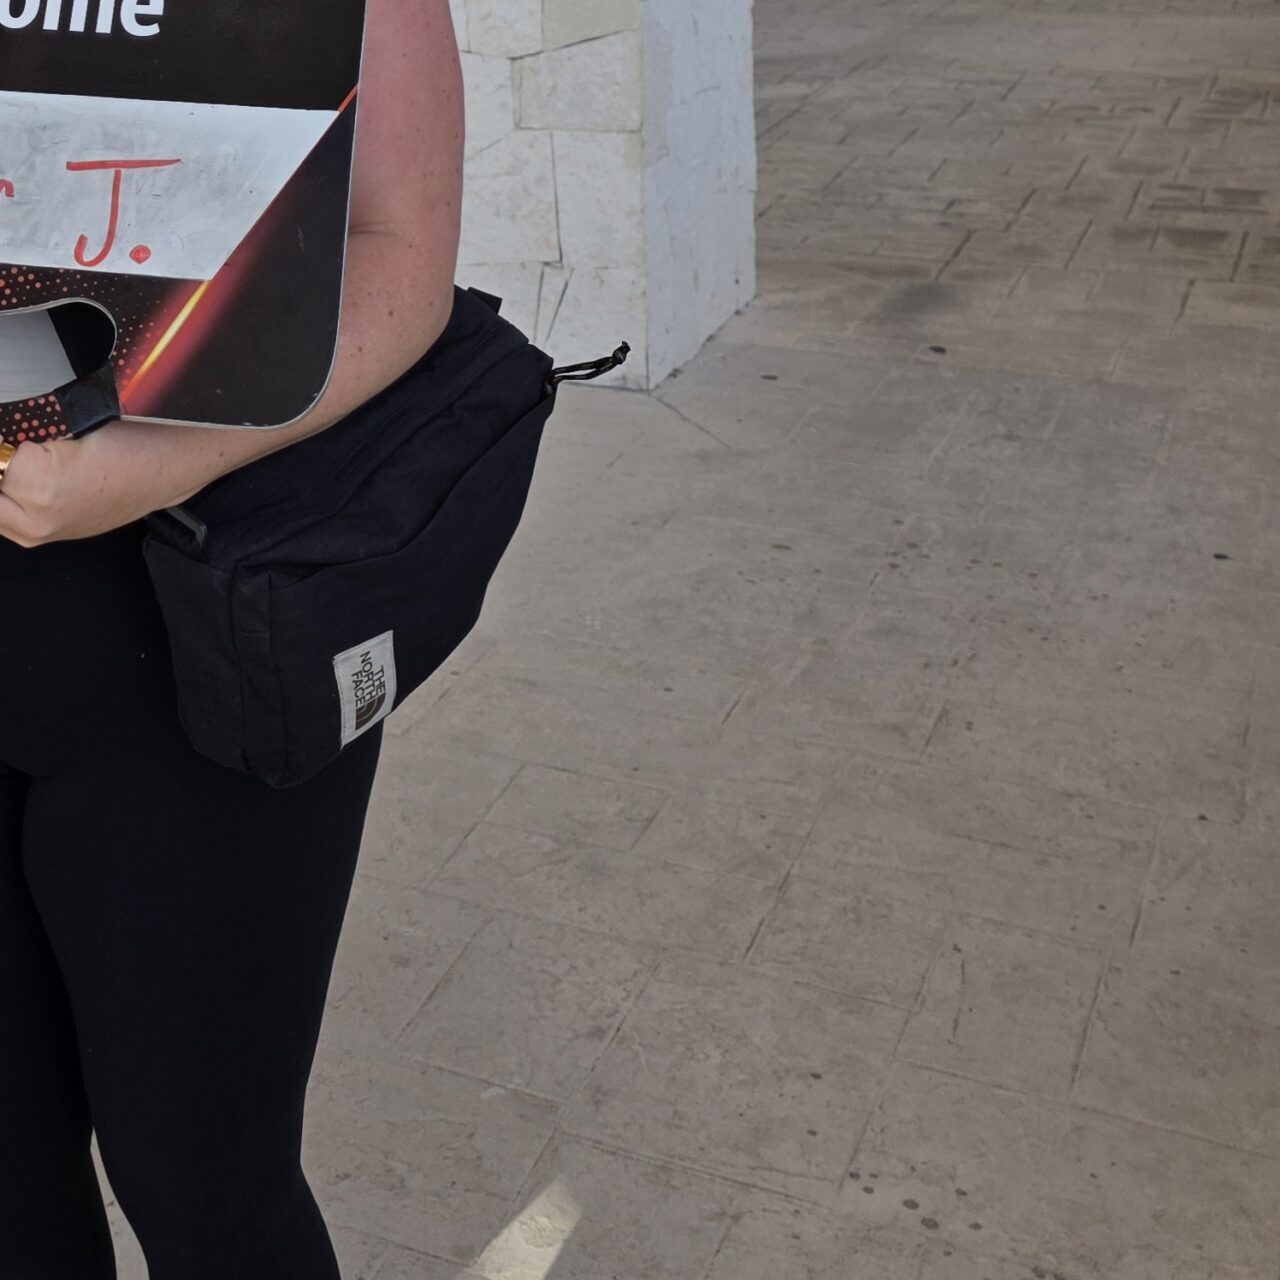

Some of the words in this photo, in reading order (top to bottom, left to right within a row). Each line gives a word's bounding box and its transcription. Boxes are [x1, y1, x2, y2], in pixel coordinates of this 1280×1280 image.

[66, 158, 182, 268] J.
[351, 672, 366, 708] FACE
[360, 650, 377, 702] NORTH
[374, 664, 385, 695] THE
